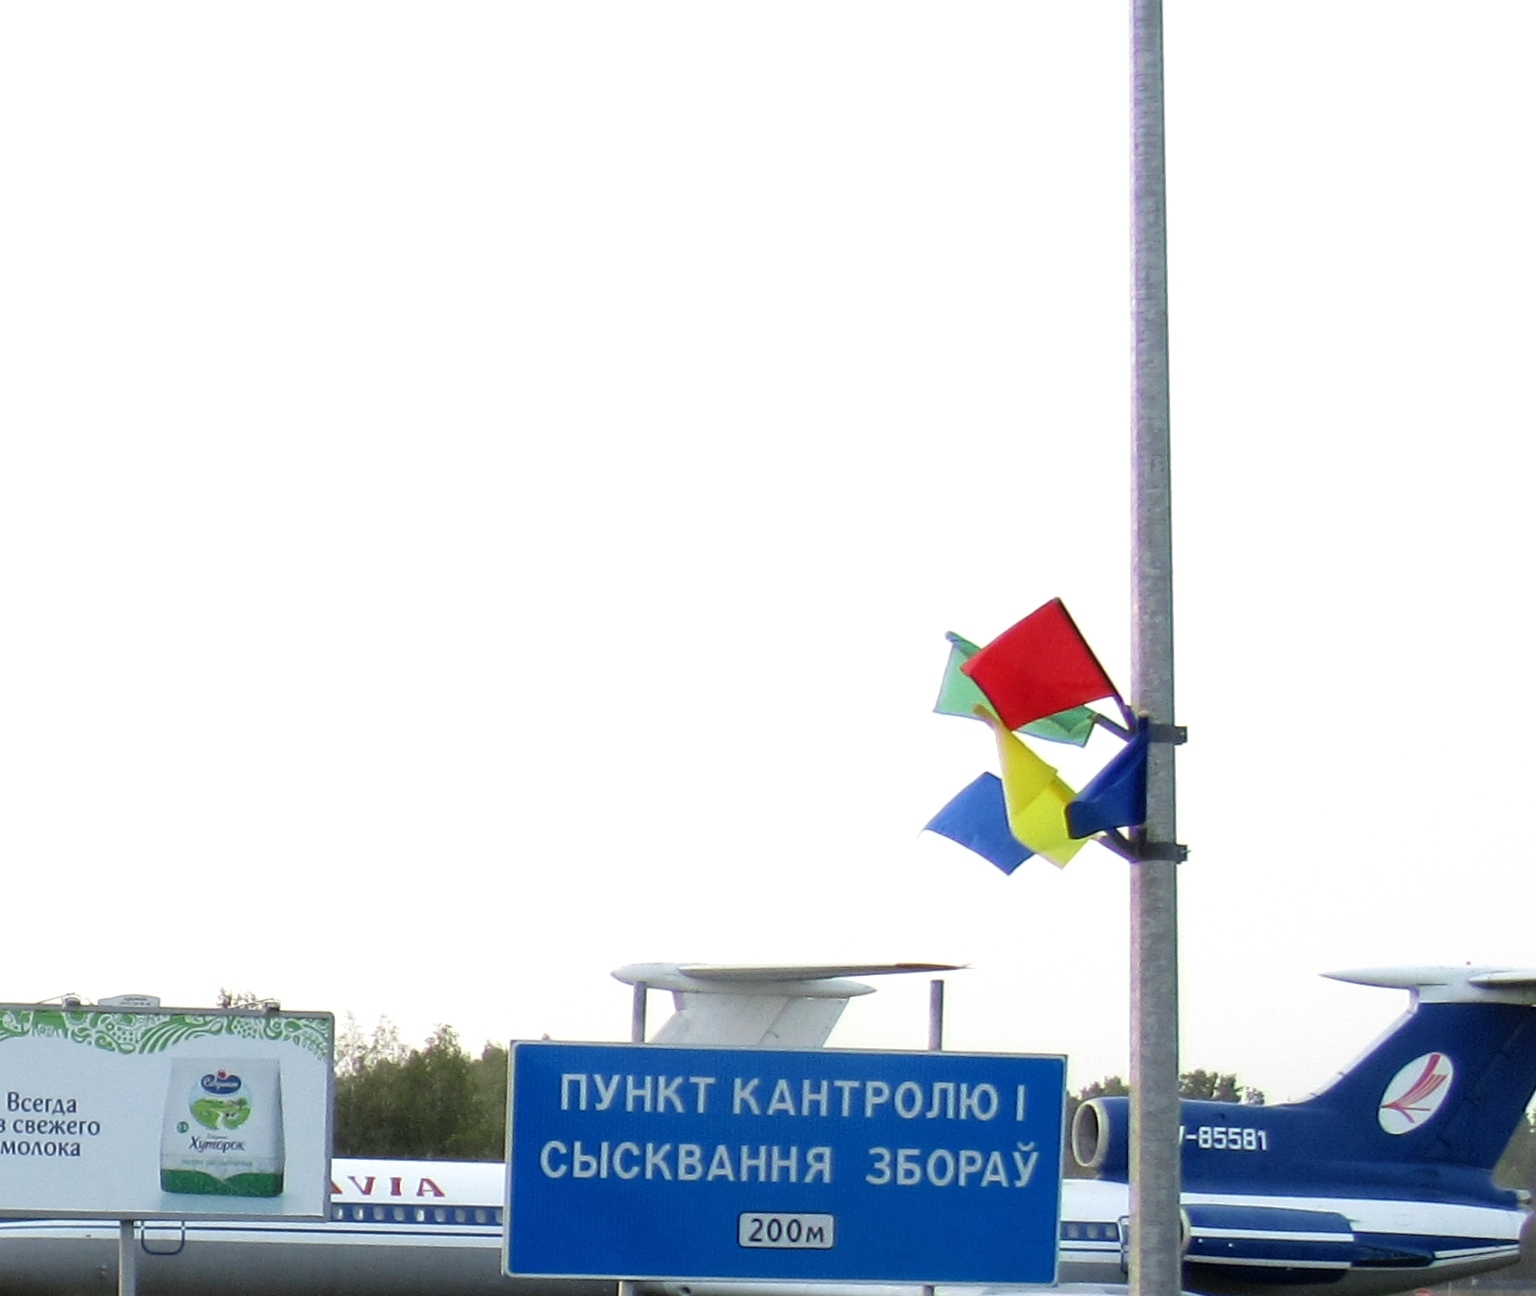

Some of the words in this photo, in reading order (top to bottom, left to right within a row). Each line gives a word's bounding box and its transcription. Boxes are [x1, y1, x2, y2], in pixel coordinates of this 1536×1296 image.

[6, 1091, 77, 1116] Всегда
[560, 1073, 716, 1114] ПУНКТ
[732, 1078, 999, 1122] КАНТРОЛЮ
[12, 1118, 101, 1136] свежего
[0, 1140, 81, 1157] молока
[188, 1135, 246, 1153] Хуторок
[539, 1140, 831, 1184] СЫСКВАННЯ
[865, 1142, 1040, 1188] ЗБОРАЎ
